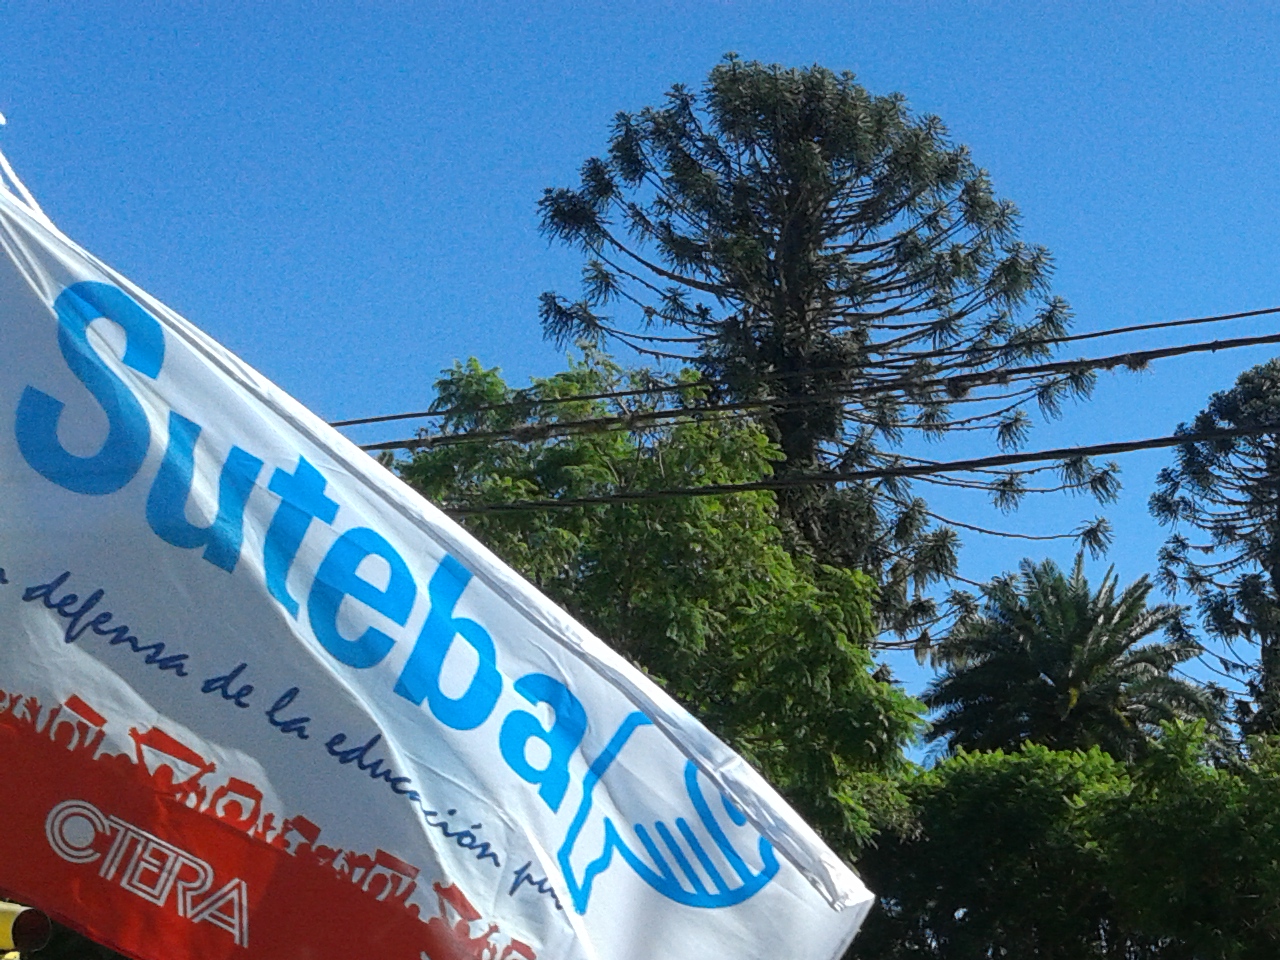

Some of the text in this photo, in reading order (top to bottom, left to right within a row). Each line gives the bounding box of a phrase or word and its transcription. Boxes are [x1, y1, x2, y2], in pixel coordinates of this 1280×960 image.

[15, 280, 587, 814] Suteba
[22, 571, 189, 677] defensa
[201, 663, 254, 708] de
[266, 687, 311, 739] la
[45, 799, 248, 948] CTERA
